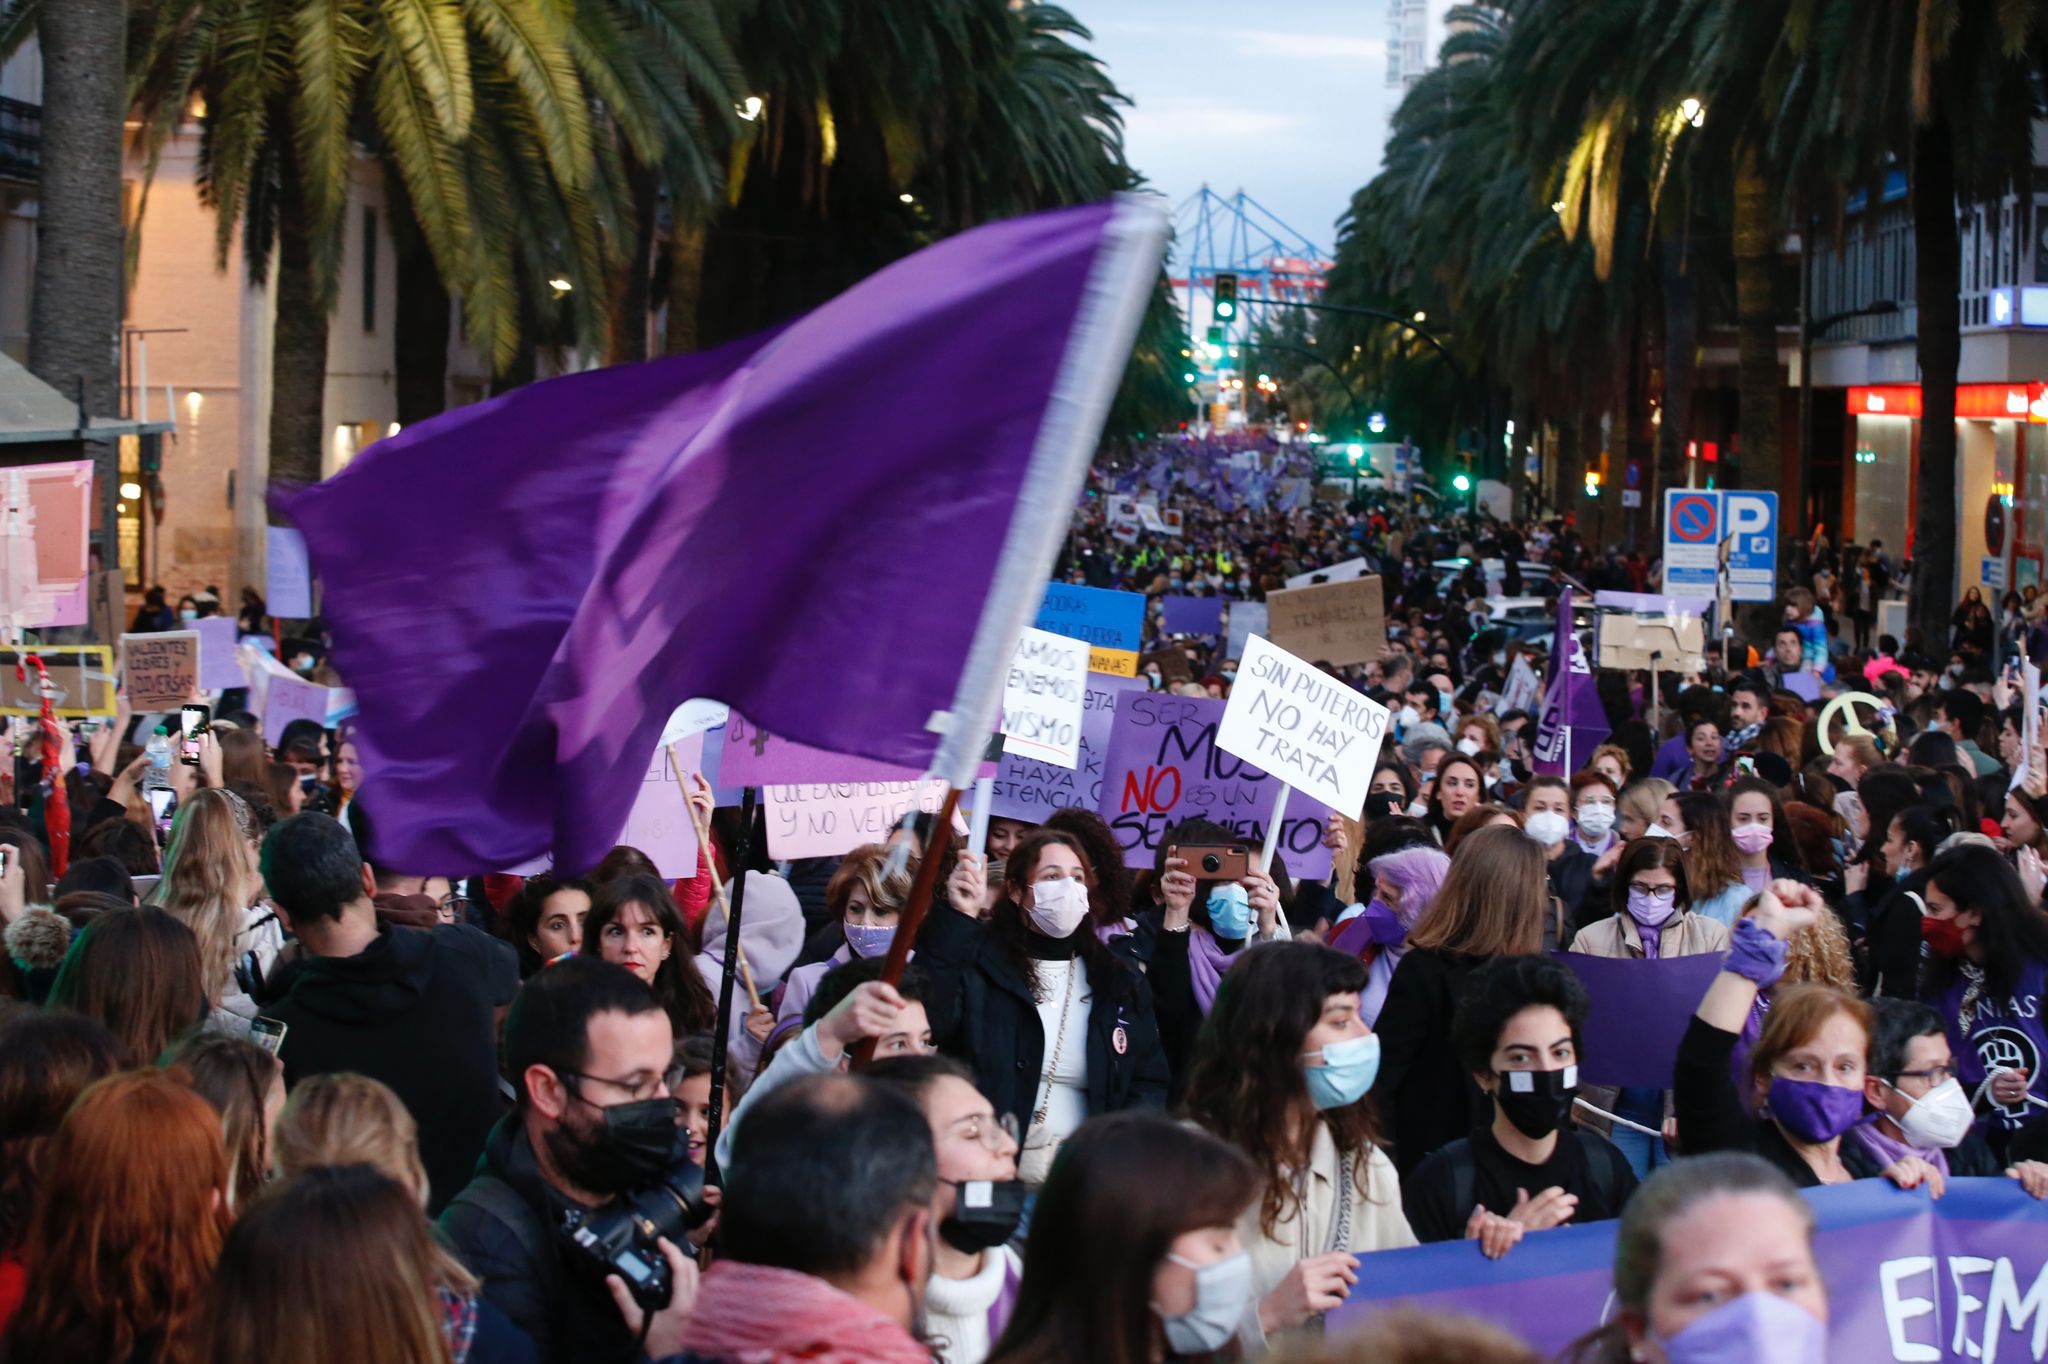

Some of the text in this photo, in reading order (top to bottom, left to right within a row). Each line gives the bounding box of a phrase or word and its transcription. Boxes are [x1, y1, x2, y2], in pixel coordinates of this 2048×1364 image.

[1727, 497, 1770, 554] P
[1041, 595, 1089, 615] ADORAS
[1013, 638, 1077, 671] AMOS
[1006, 666, 1079, 703] ENEMOS
[1083, 689, 1116, 713] eTA
[1250, 654, 1384, 740] SIN PUTEROS
[1001, 707, 1074, 746] NISMO
[1130, 698, 1207, 728] SER
[1249, 689, 1355, 758] NO HAY
[1009, 764, 1075, 789] HAYA
[1258, 727, 1340, 794] TRATA
[992, 780, 1084, 808] STENCIA
[1121, 765, 1181, 814] NO
[1223, 782, 1258, 806] UN
[808, 810, 837, 837] NO
[1111, 809, 1322, 853] SENIENTO
